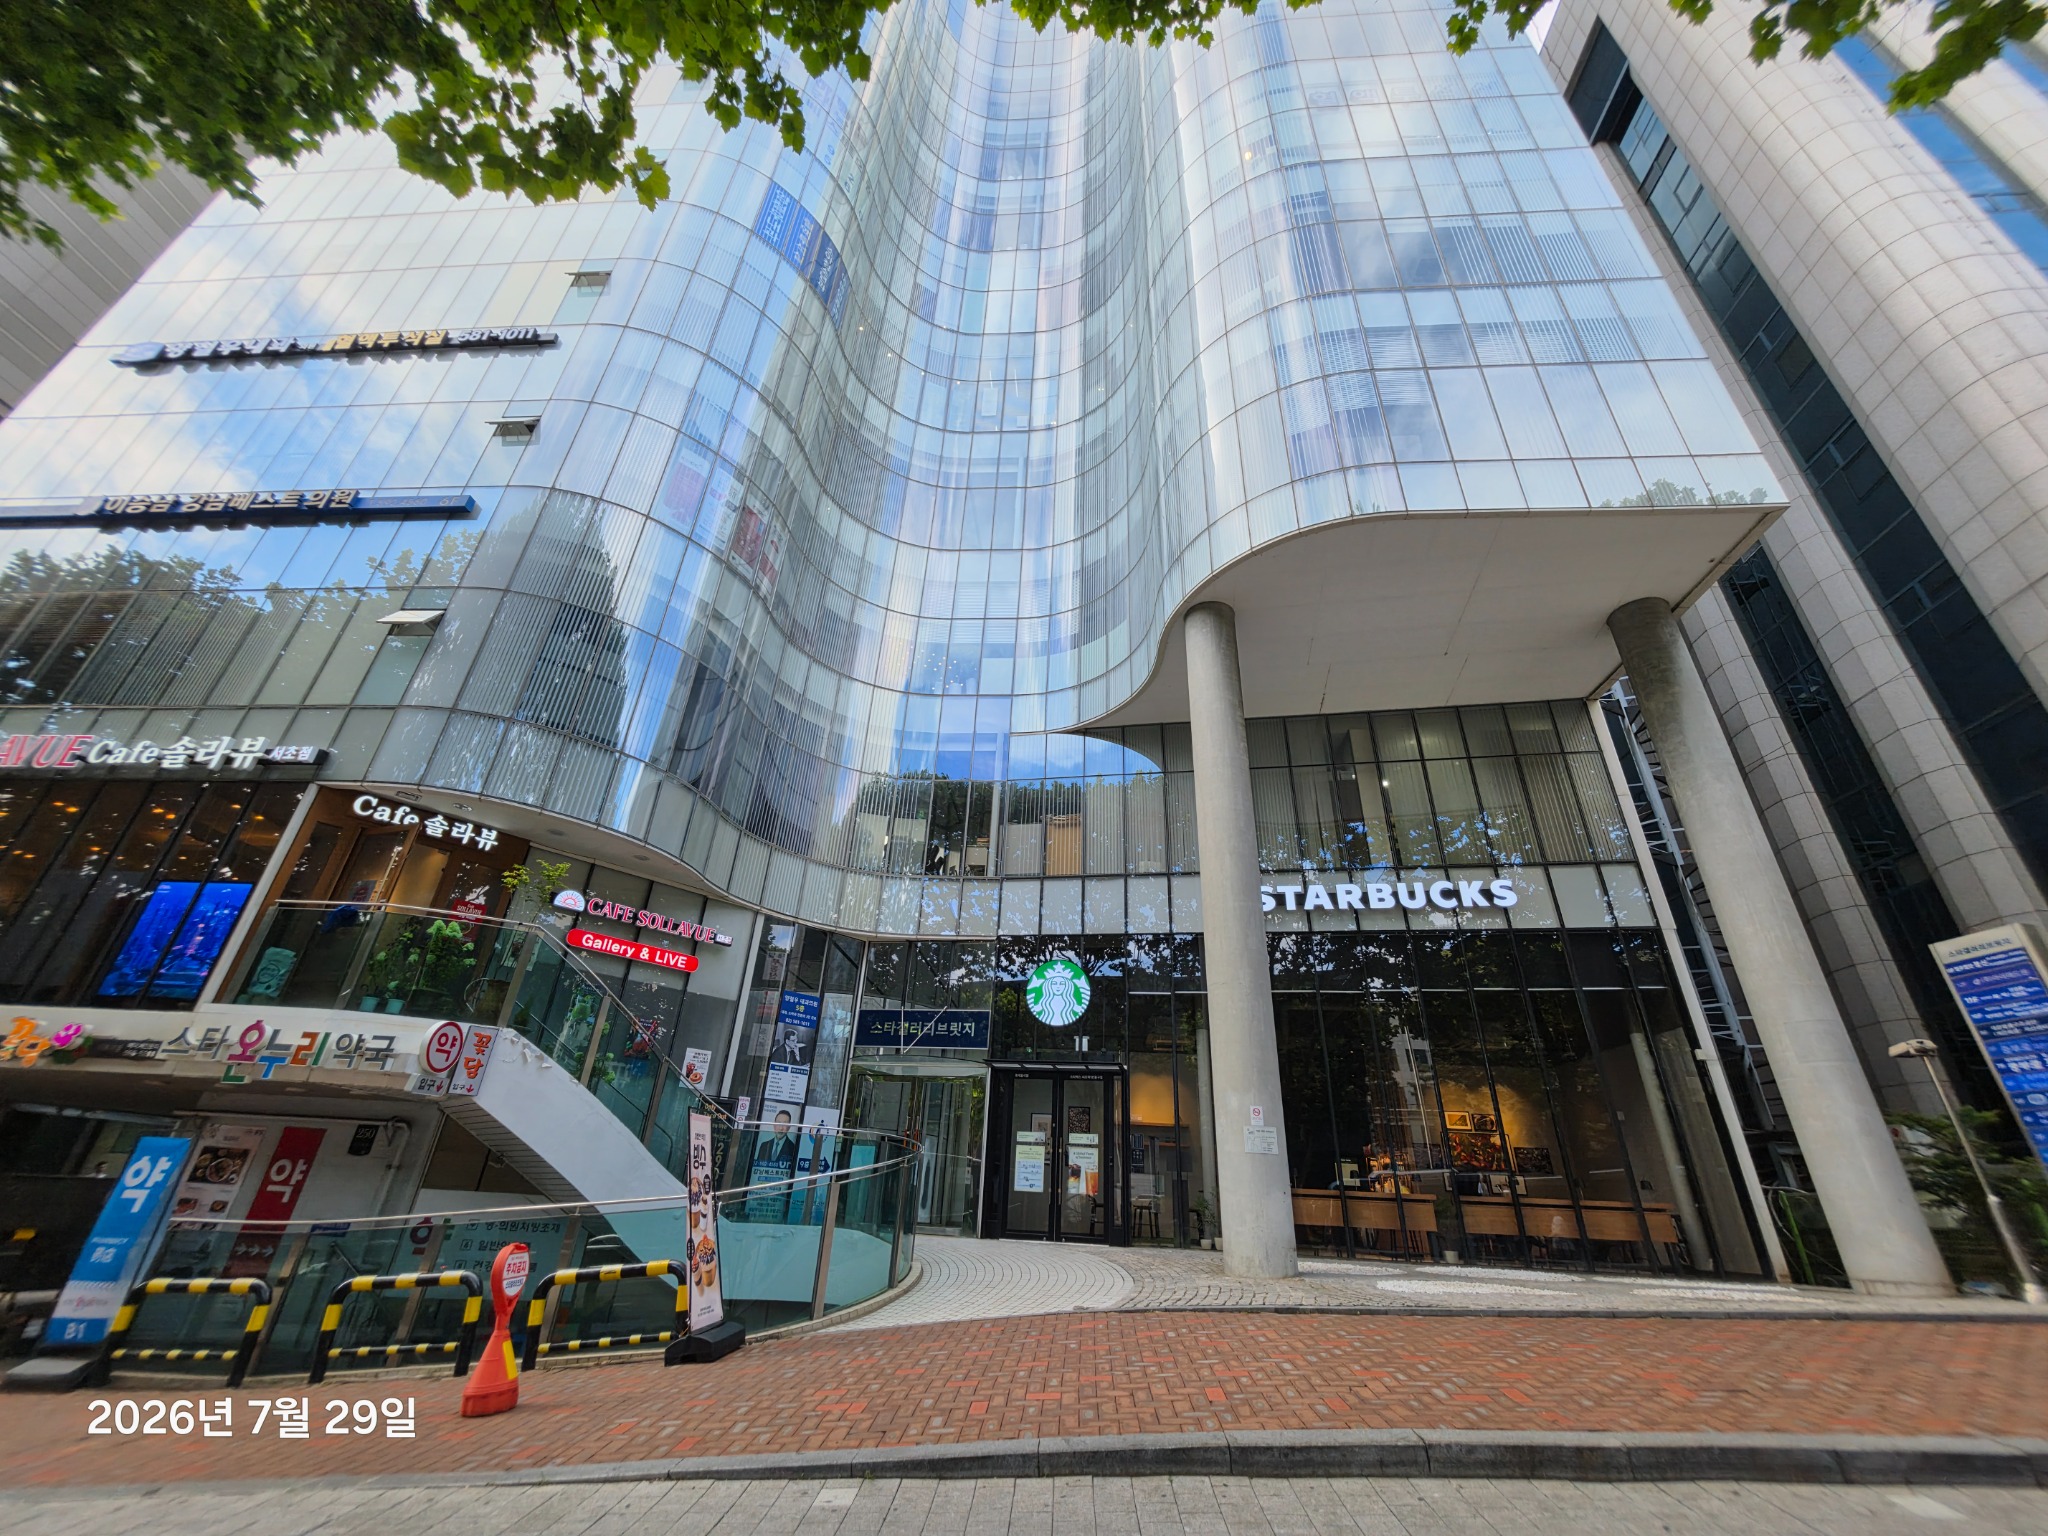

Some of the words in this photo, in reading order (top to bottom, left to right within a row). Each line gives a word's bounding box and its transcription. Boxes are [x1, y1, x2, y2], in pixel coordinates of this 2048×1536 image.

[335, 329, 448, 350] 혈액투석실
[457, 328, 535, 341] 581-1011
[86, 740, 160, 765] Cafe
[160, 736, 269, 770] 솔라뷰
[268, 745, 313, 761] 서초점
[352, 794, 420, 825] Cafe
[423, 814, 499, 851] 솔라뷰
[587, 897, 636, 923] CAFE
[636, 909, 716, 944] SOLLAVUE
[581, 933, 636, 957] Gallery
[638, 948, 650, 960] &
[654, 950, 688, 968] LIVE
[869, 1020, 976, 1037] 스타갤러리브릿지
[435, 1030, 458, 1063] 약
[463, 1031, 492, 1080] 꽃담
[417, 1078, 436, 1092] 입구
[120, 1155, 173, 1213] 약
[266, 1158, 310, 1203] 약
[64, 1322, 88, 1340] B1
